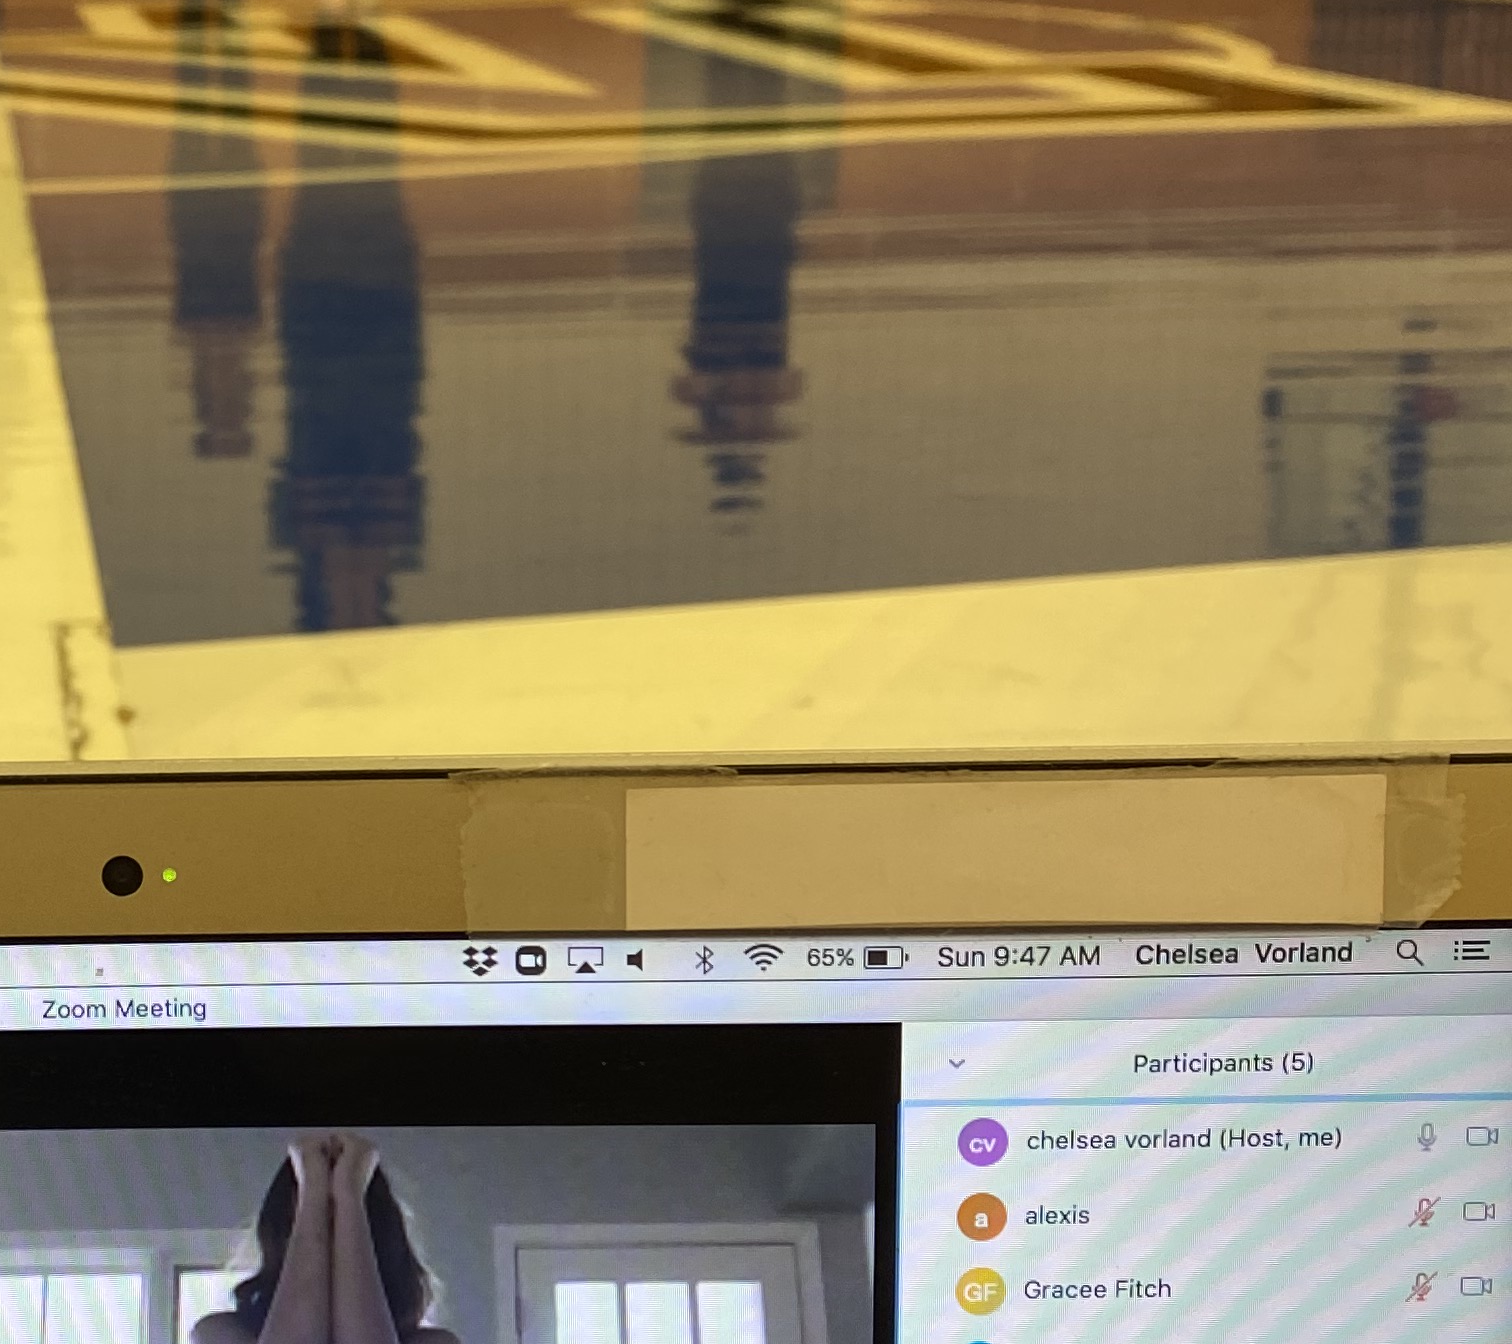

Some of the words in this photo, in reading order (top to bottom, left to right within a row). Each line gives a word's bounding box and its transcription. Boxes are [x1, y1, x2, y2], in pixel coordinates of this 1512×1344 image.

[807, 948, 855, 967] 65%
[937, 946, 985, 968] Sun
[994, 945, 1051, 967] 9:47
[1059, 945, 1101, 966] AM
[1136, 943, 1239, 965] Chelsea
[1254, 942, 1353, 964] Vorland
[42, 1000, 107, 1019] Zoom
[115, 997, 207, 1020] Meeting
[1134, 1052, 1273, 1077] Participants
[1282, 1052, 1314, 1075] (5)
[1027, 1129, 1116, 1150] chelsea
[1124, 1127, 1212, 1149] vorland
[1220, 1128, 1289, 1151] (Host,
[1299, 1127, 1342, 1150] me)
[974, 1212, 989, 1228] a
[1025, 1204, 1090, 1225] alexis
[962, 1282, 998, 1303] GF
[1024, 1279, 1107, 1300] Gracee
[1115, 1278, 1172, 1298] Fitch
